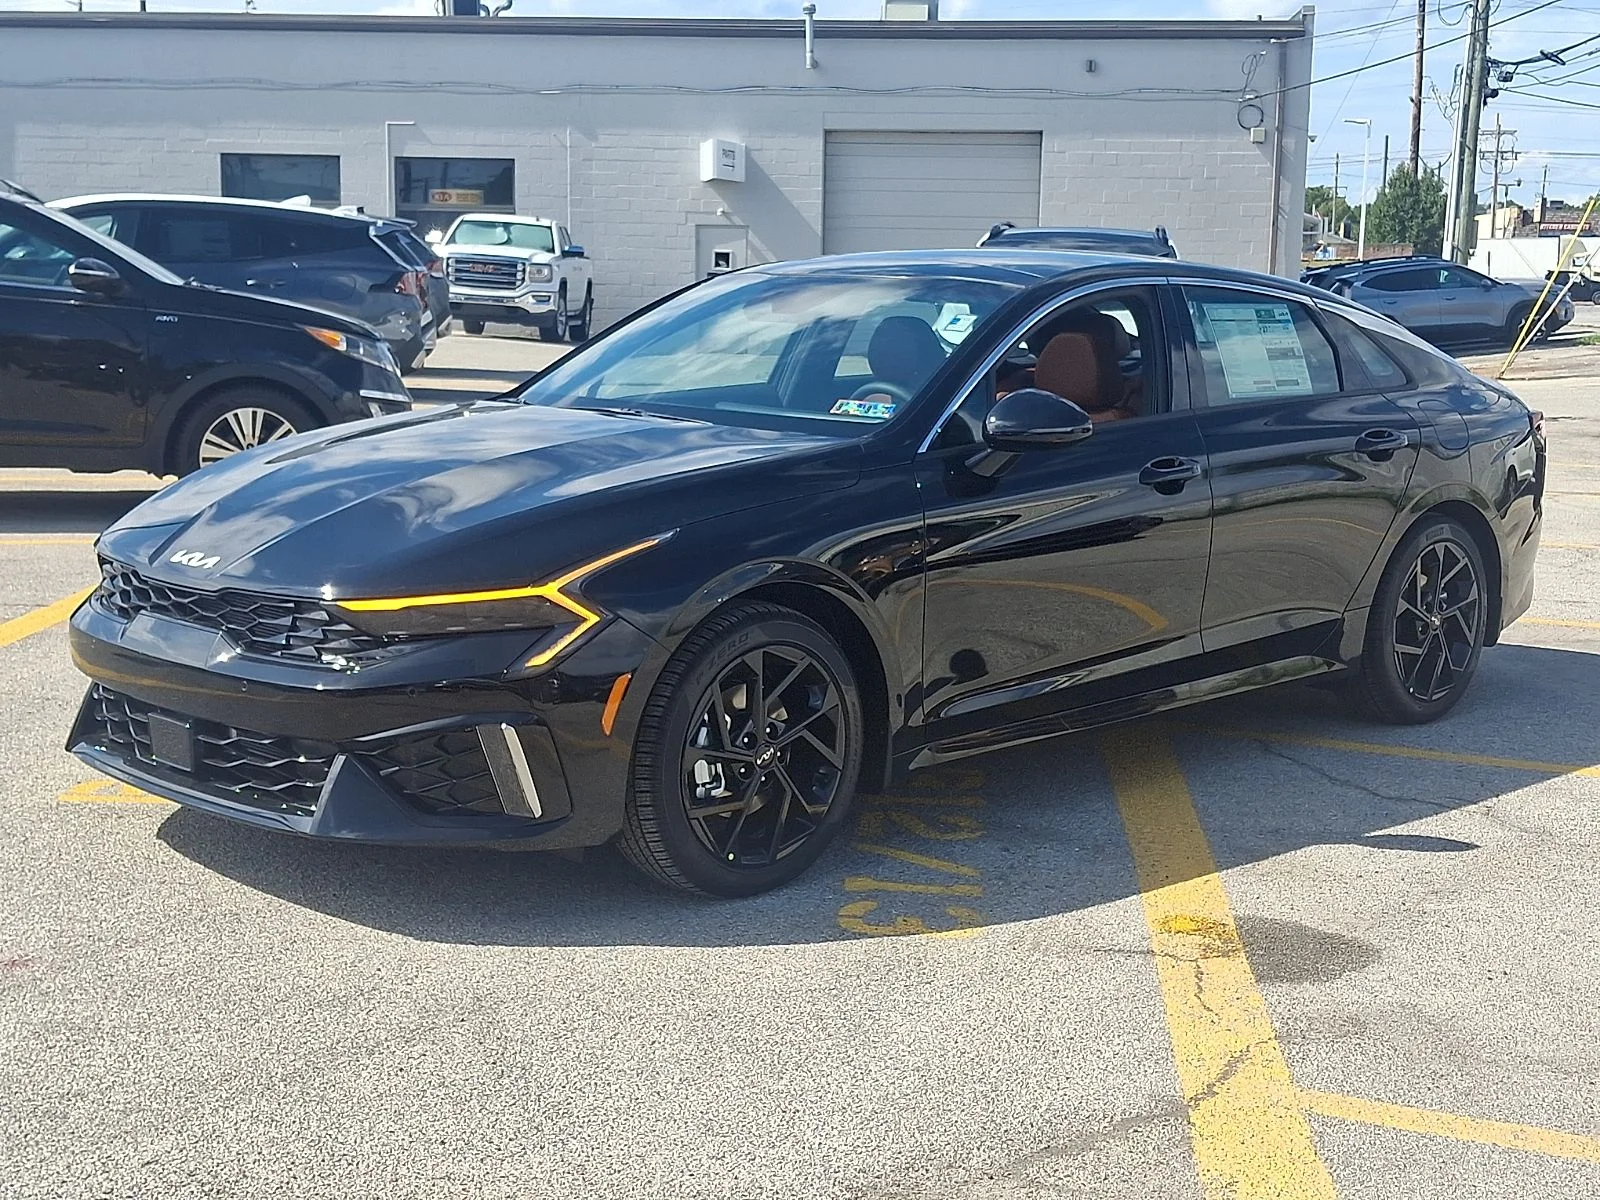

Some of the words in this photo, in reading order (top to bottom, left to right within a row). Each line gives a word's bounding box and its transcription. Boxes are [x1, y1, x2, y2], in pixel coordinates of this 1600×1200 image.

[469, 263, 497, 273] GMC
[155, 315, 179, 323] AWD
[169, 549, 221, 569] KIA
